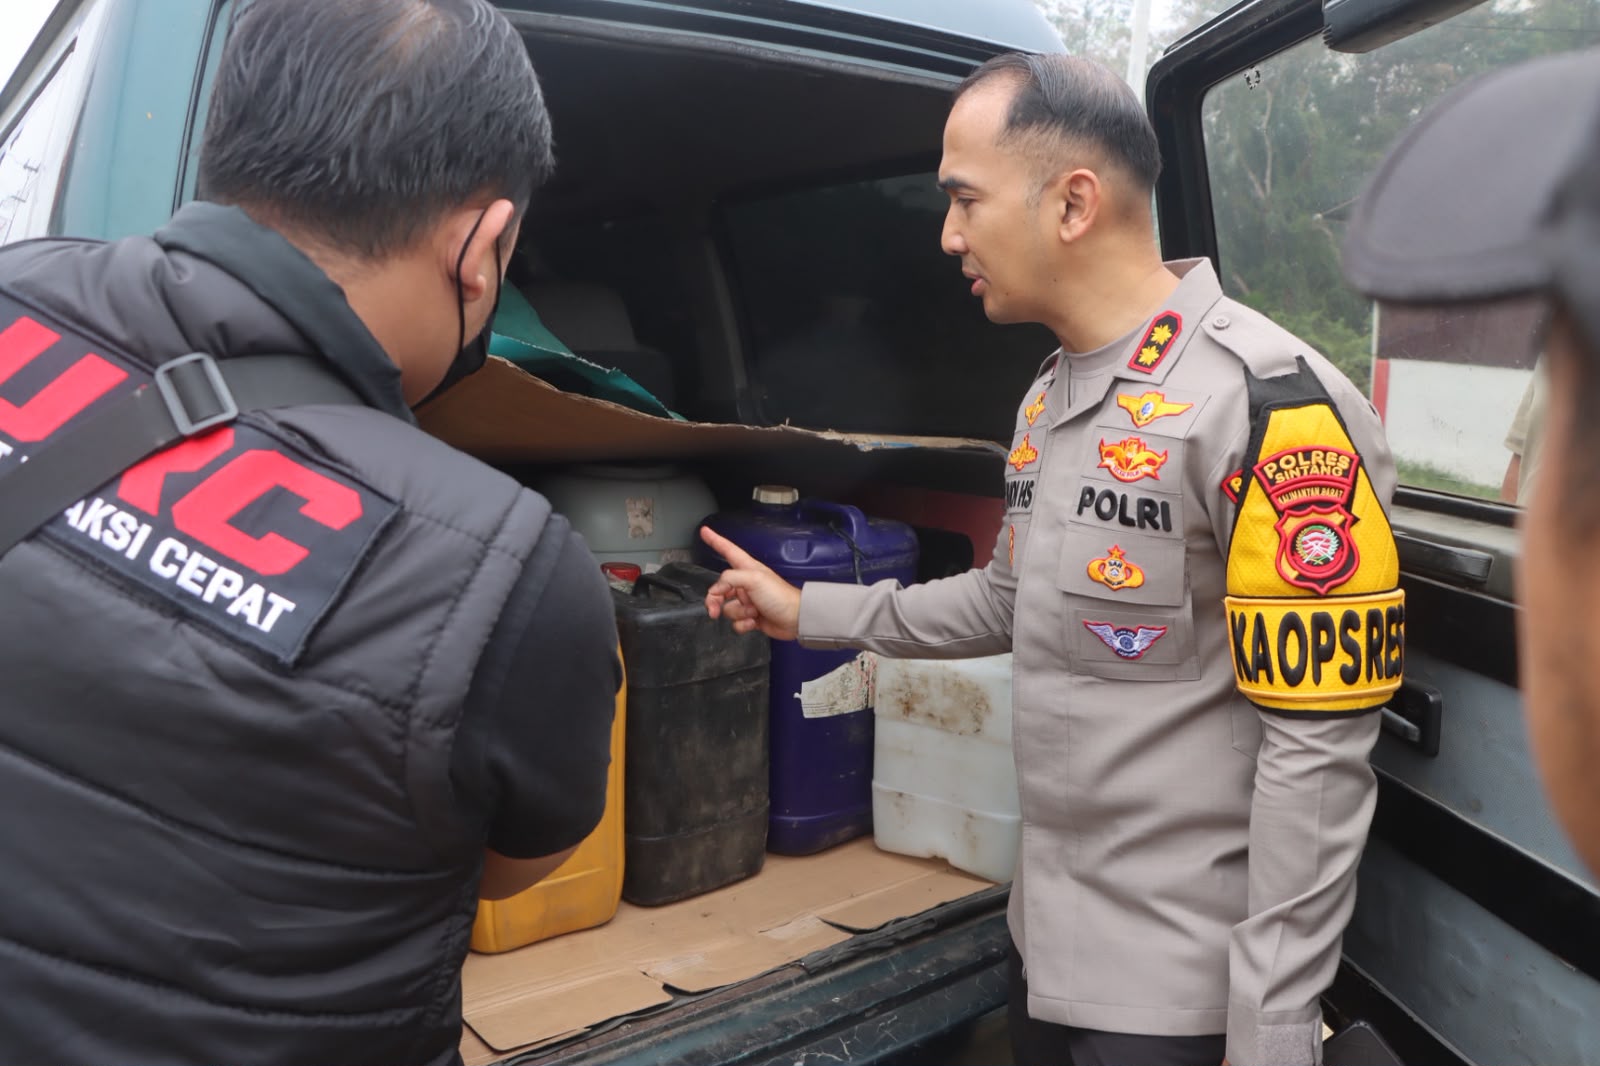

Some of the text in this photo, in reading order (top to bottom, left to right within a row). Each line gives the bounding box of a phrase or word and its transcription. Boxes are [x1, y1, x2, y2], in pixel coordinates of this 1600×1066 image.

[1263, 450, 1350, 479] POLRES
[1275, 465, 1343, 484] SINTANG
[1077, 486, 1172, 532] POLRI
[149, 536, 296, 633] CEPAT
